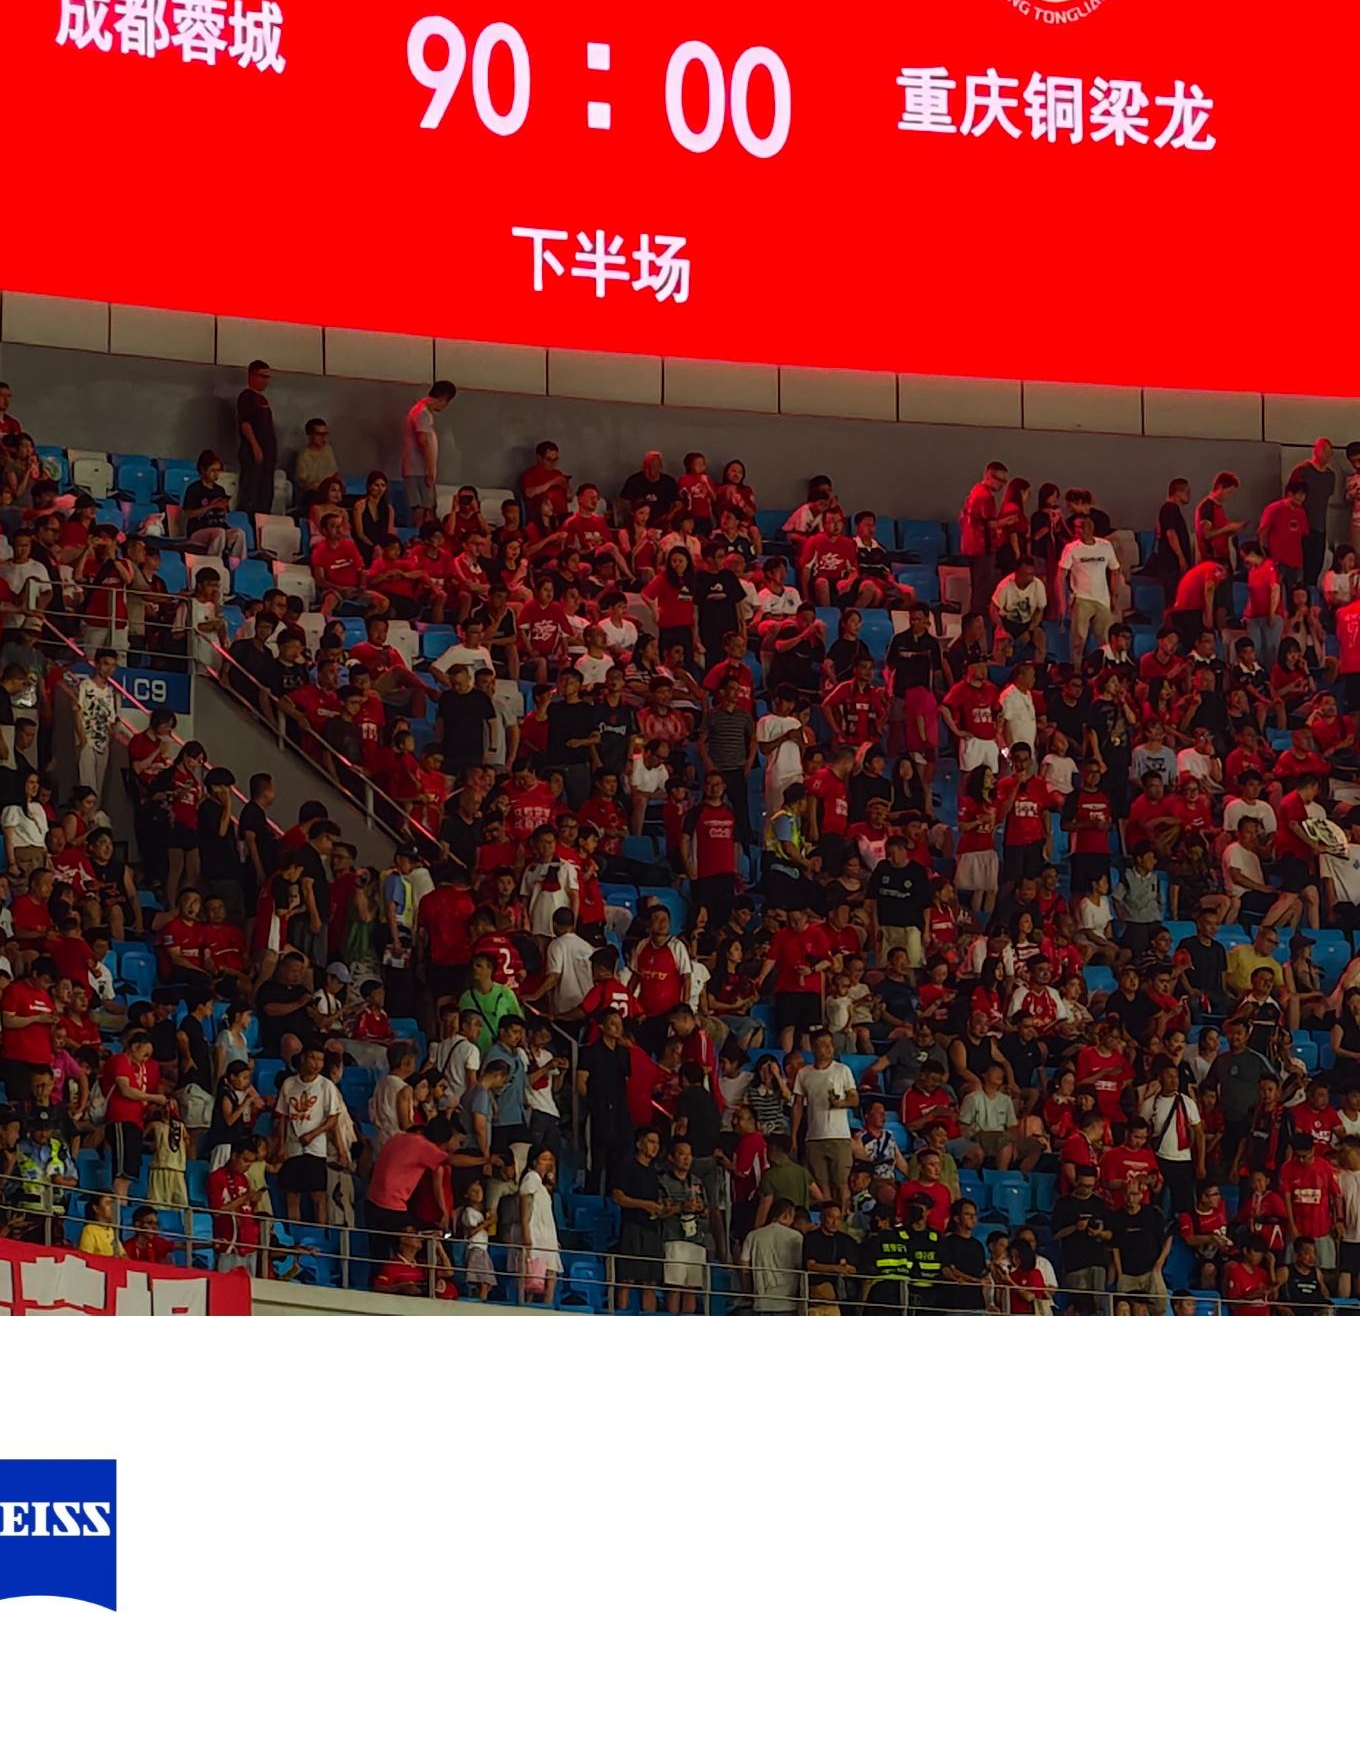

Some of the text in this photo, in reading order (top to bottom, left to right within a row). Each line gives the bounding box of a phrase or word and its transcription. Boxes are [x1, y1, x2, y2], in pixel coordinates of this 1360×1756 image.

[895, 66, 1217, 151] 重庆铜梁龙
[511, 226, 691, 304] 下半场
[133, 678, 167, 703] C9
